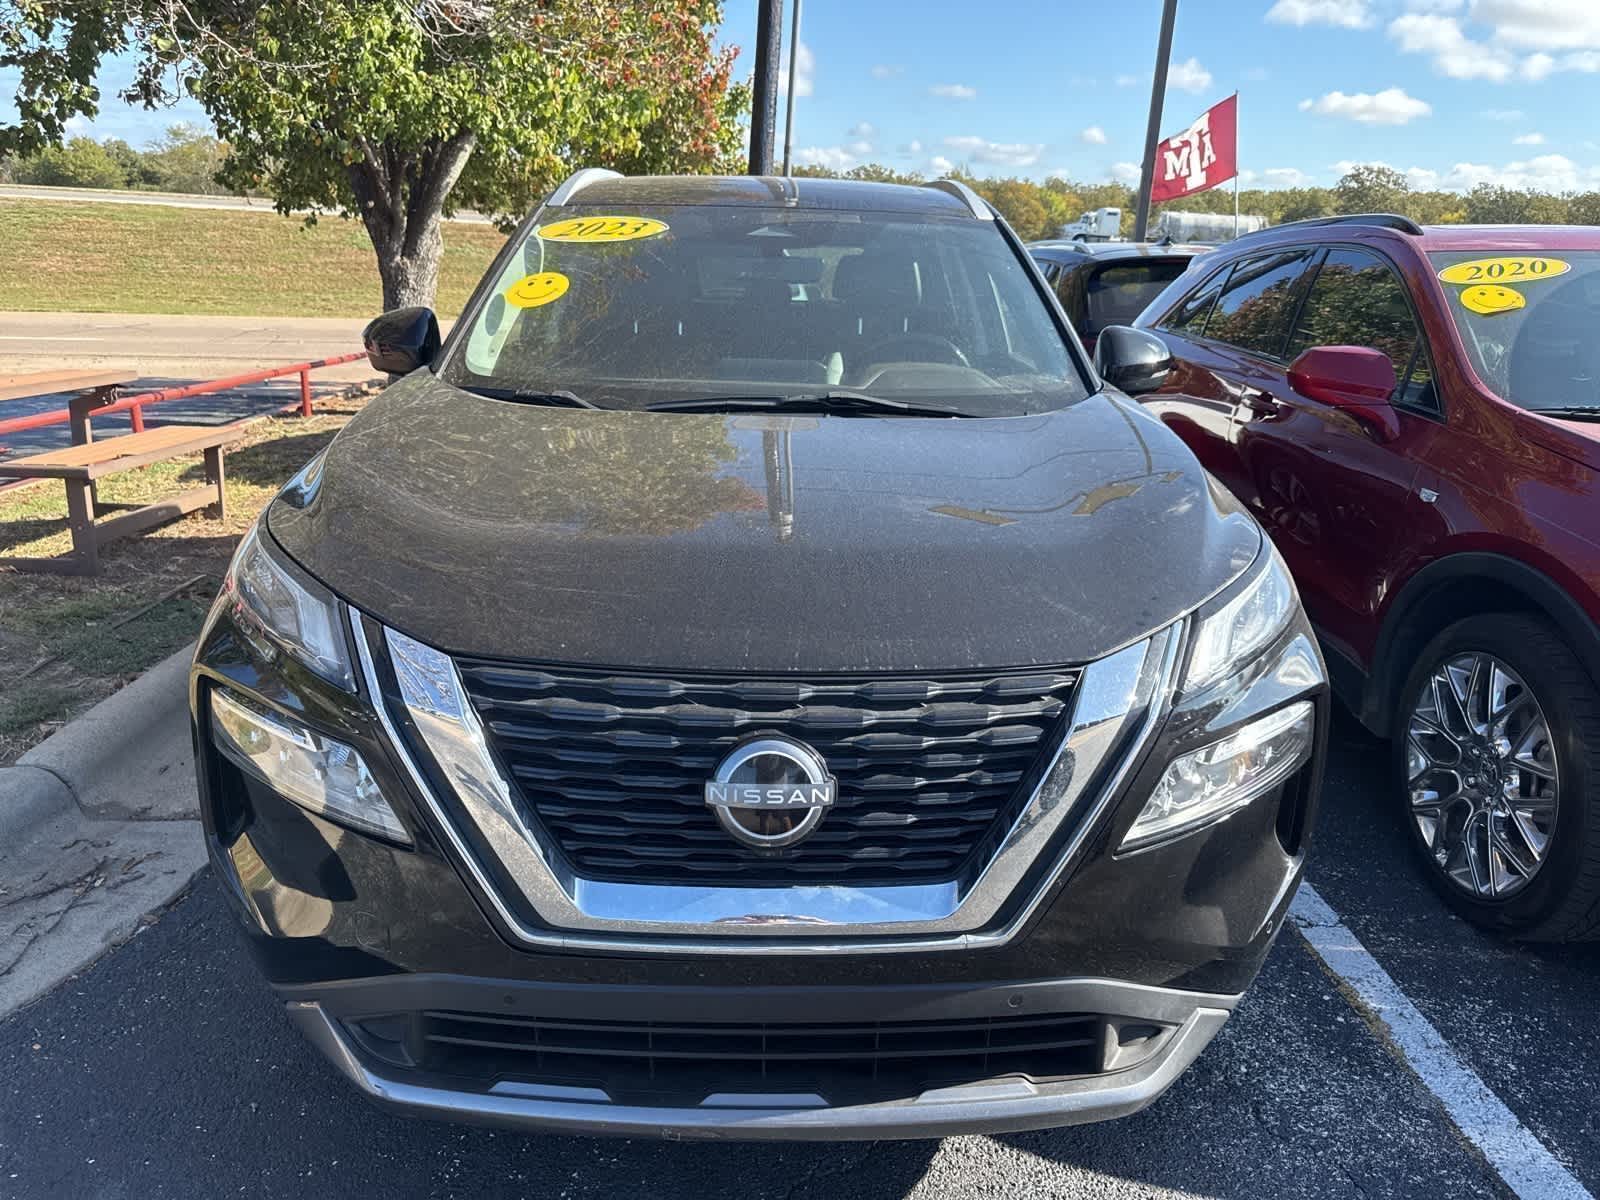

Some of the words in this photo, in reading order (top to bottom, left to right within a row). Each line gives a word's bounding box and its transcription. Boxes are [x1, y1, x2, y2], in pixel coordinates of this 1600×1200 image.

[553, 221, 649, 238] 2023
[1466, 260, 1548, 281] 2020
[709, 786, 830, 804] NISSAN
